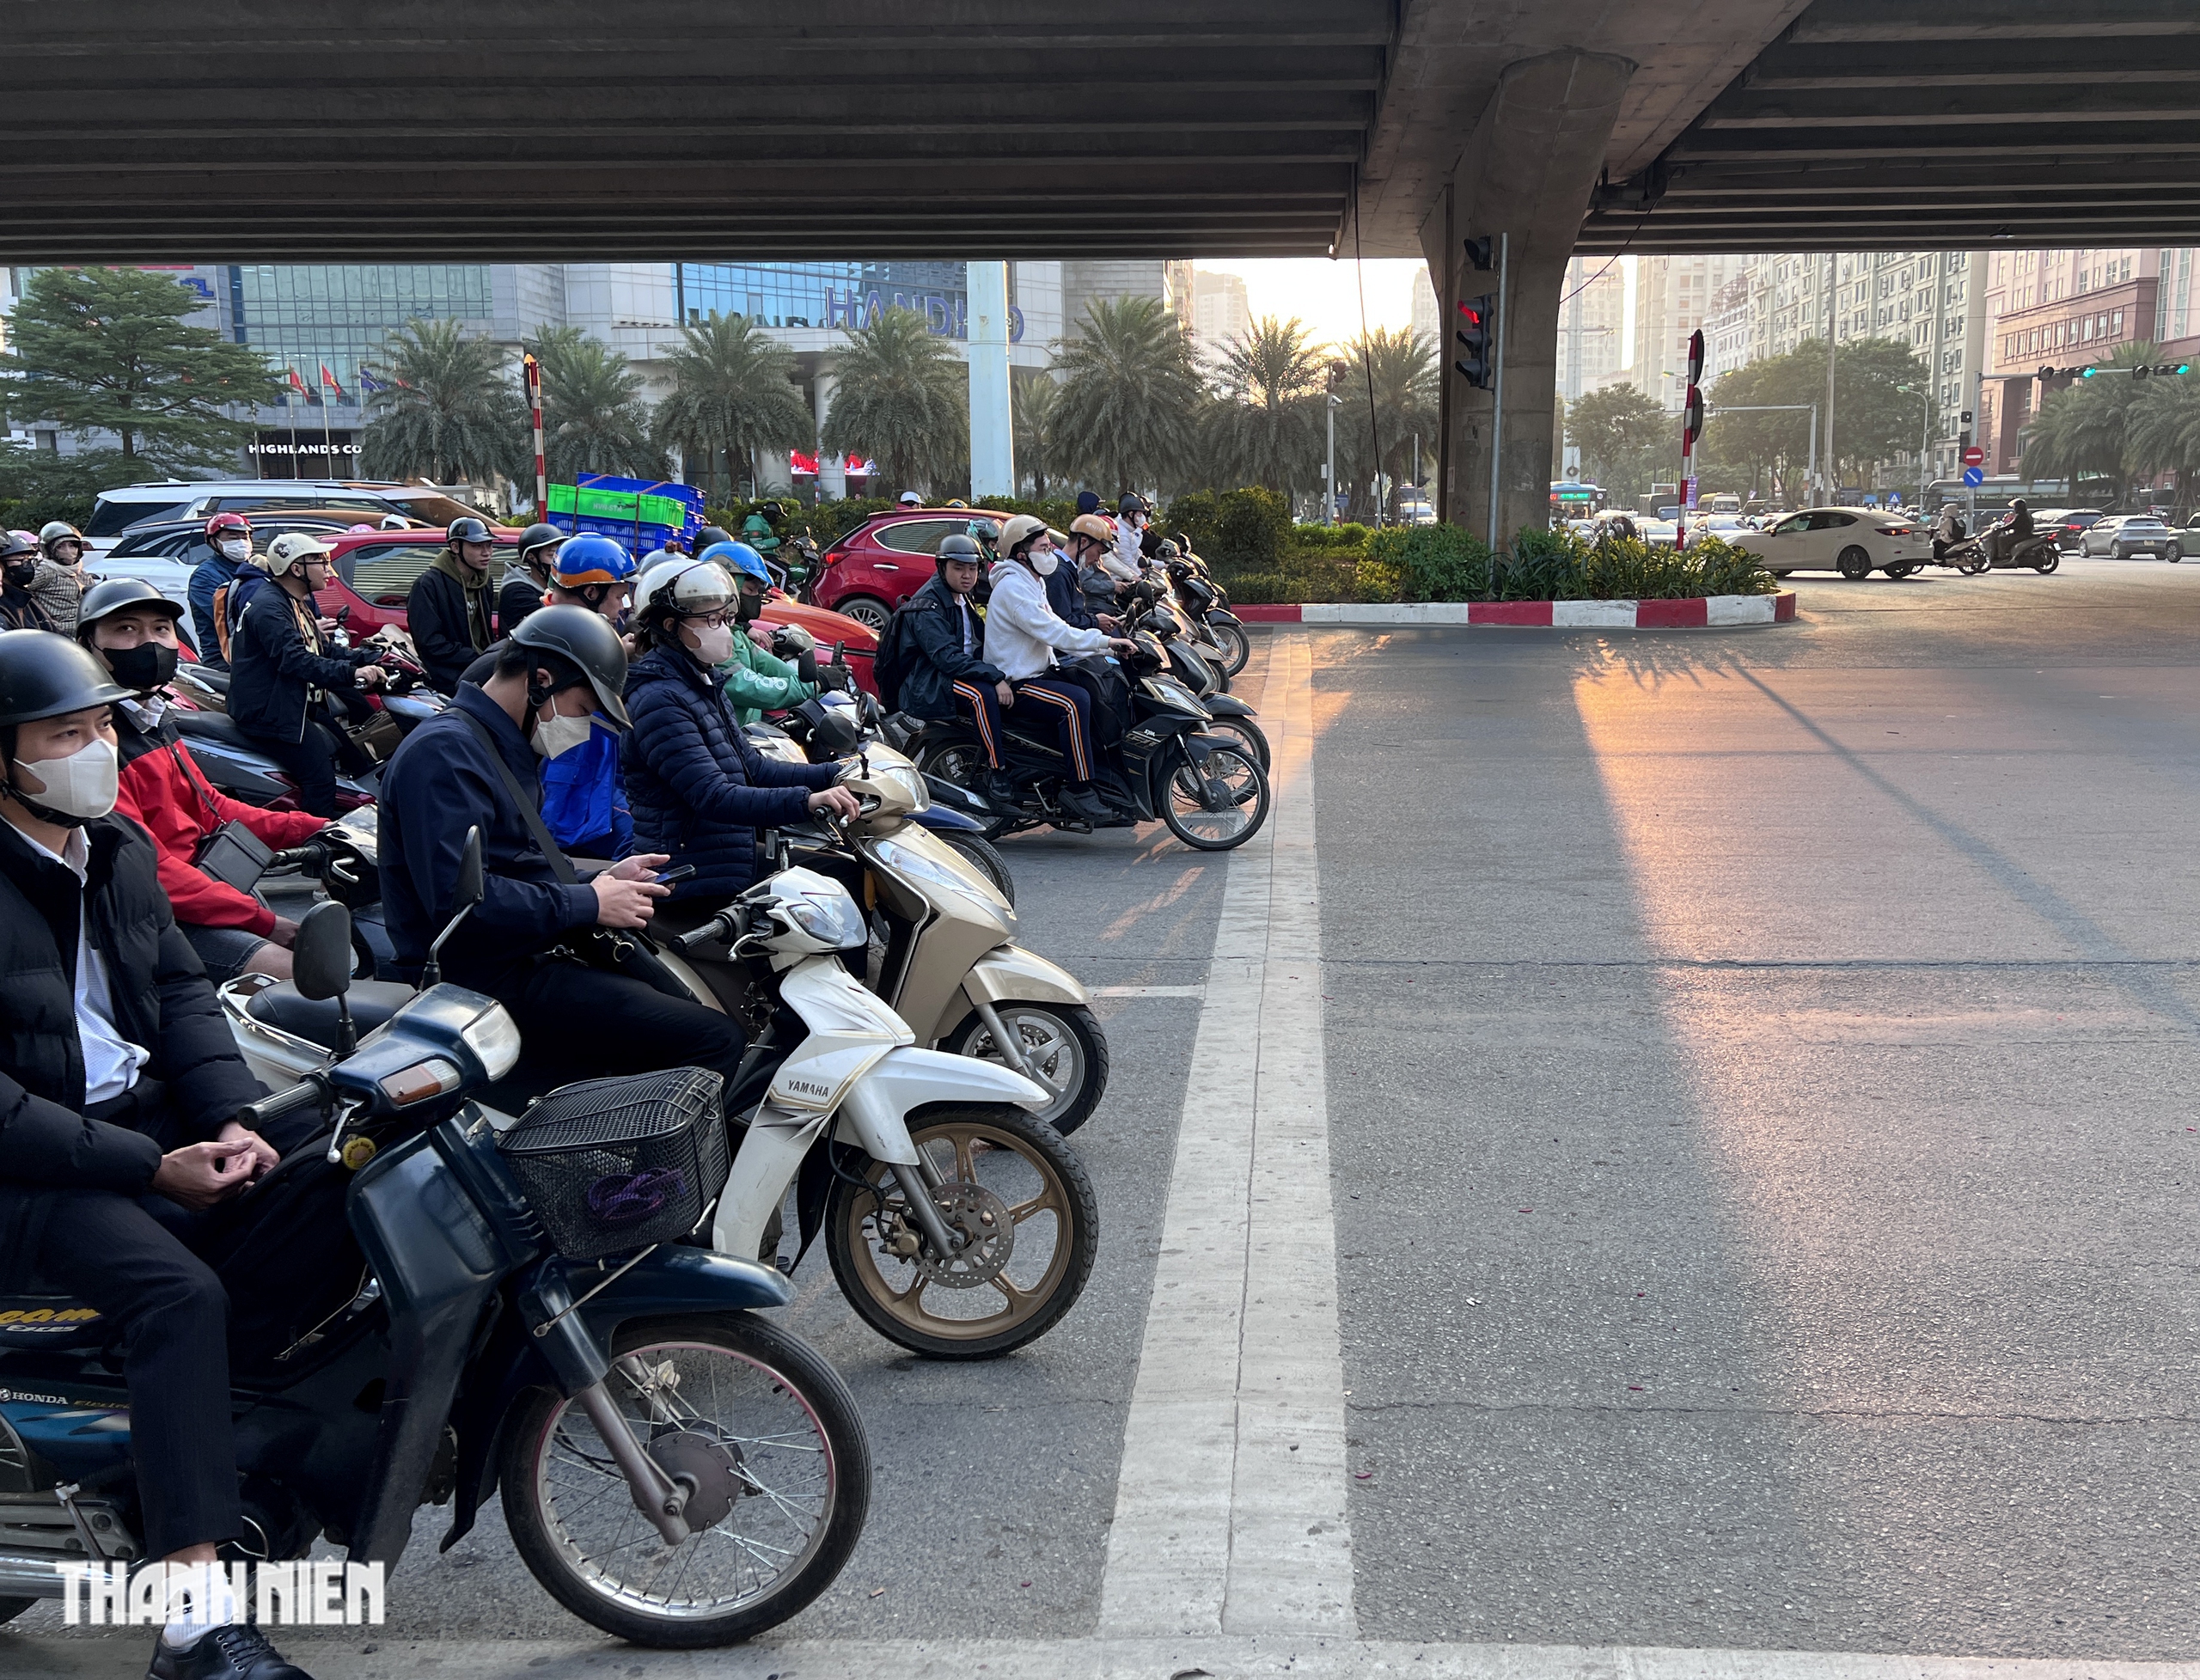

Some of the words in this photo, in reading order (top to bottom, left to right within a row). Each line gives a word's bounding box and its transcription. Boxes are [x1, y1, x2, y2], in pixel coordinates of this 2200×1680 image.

[825, 285, 1025, 343] HANDIO
[248, 444, 339, 454] HIGHLANDS
[788, 1079, 829, 1097] YAMAHA
[12, 1391, 69, 1405] HONDA
